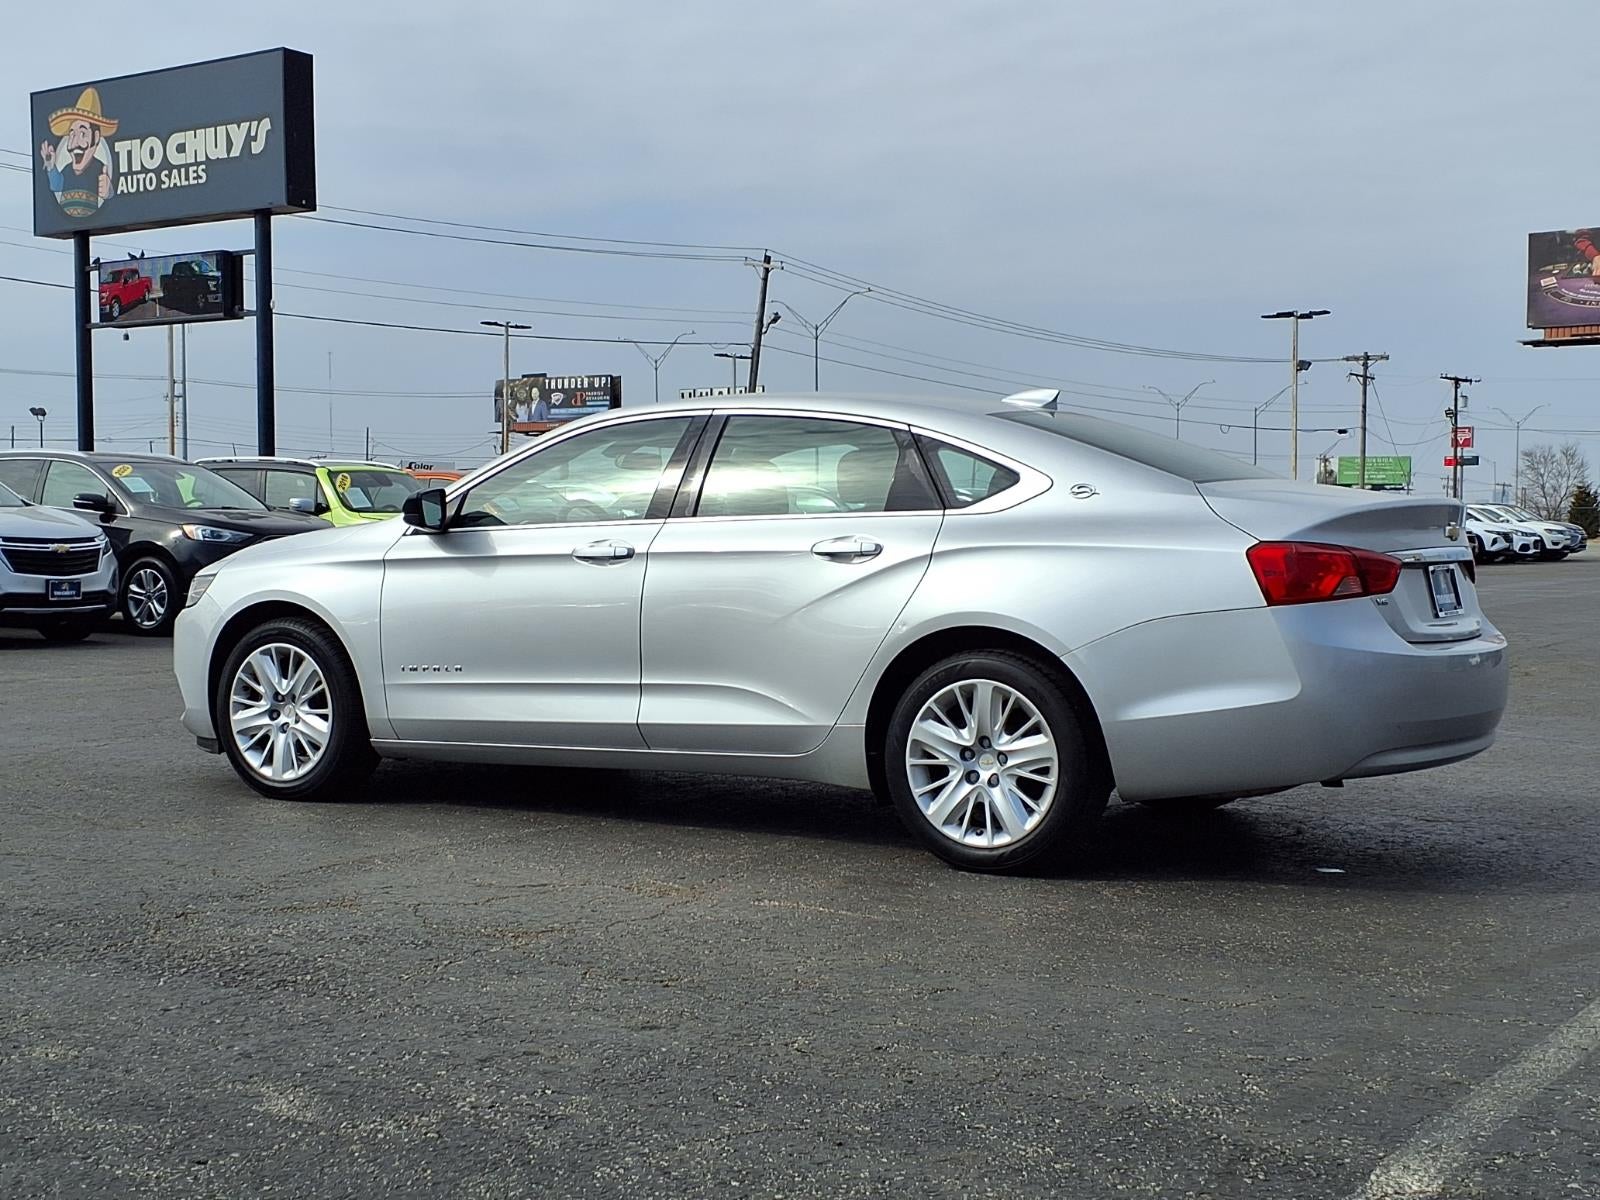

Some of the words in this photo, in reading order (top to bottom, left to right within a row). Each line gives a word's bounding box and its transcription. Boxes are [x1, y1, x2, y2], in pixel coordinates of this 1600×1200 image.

[114, 136, 164, 173] TIO
[165, 117, 272, 166] CHUY'S
[116, 172, 157, 195] AUTO
[160, 164, 207, 189] SALES
[545, 377, 589, 390] THUNDER
[594, 376, 611, 388] UP!
[400, 664, 463, 673] IMPALA
